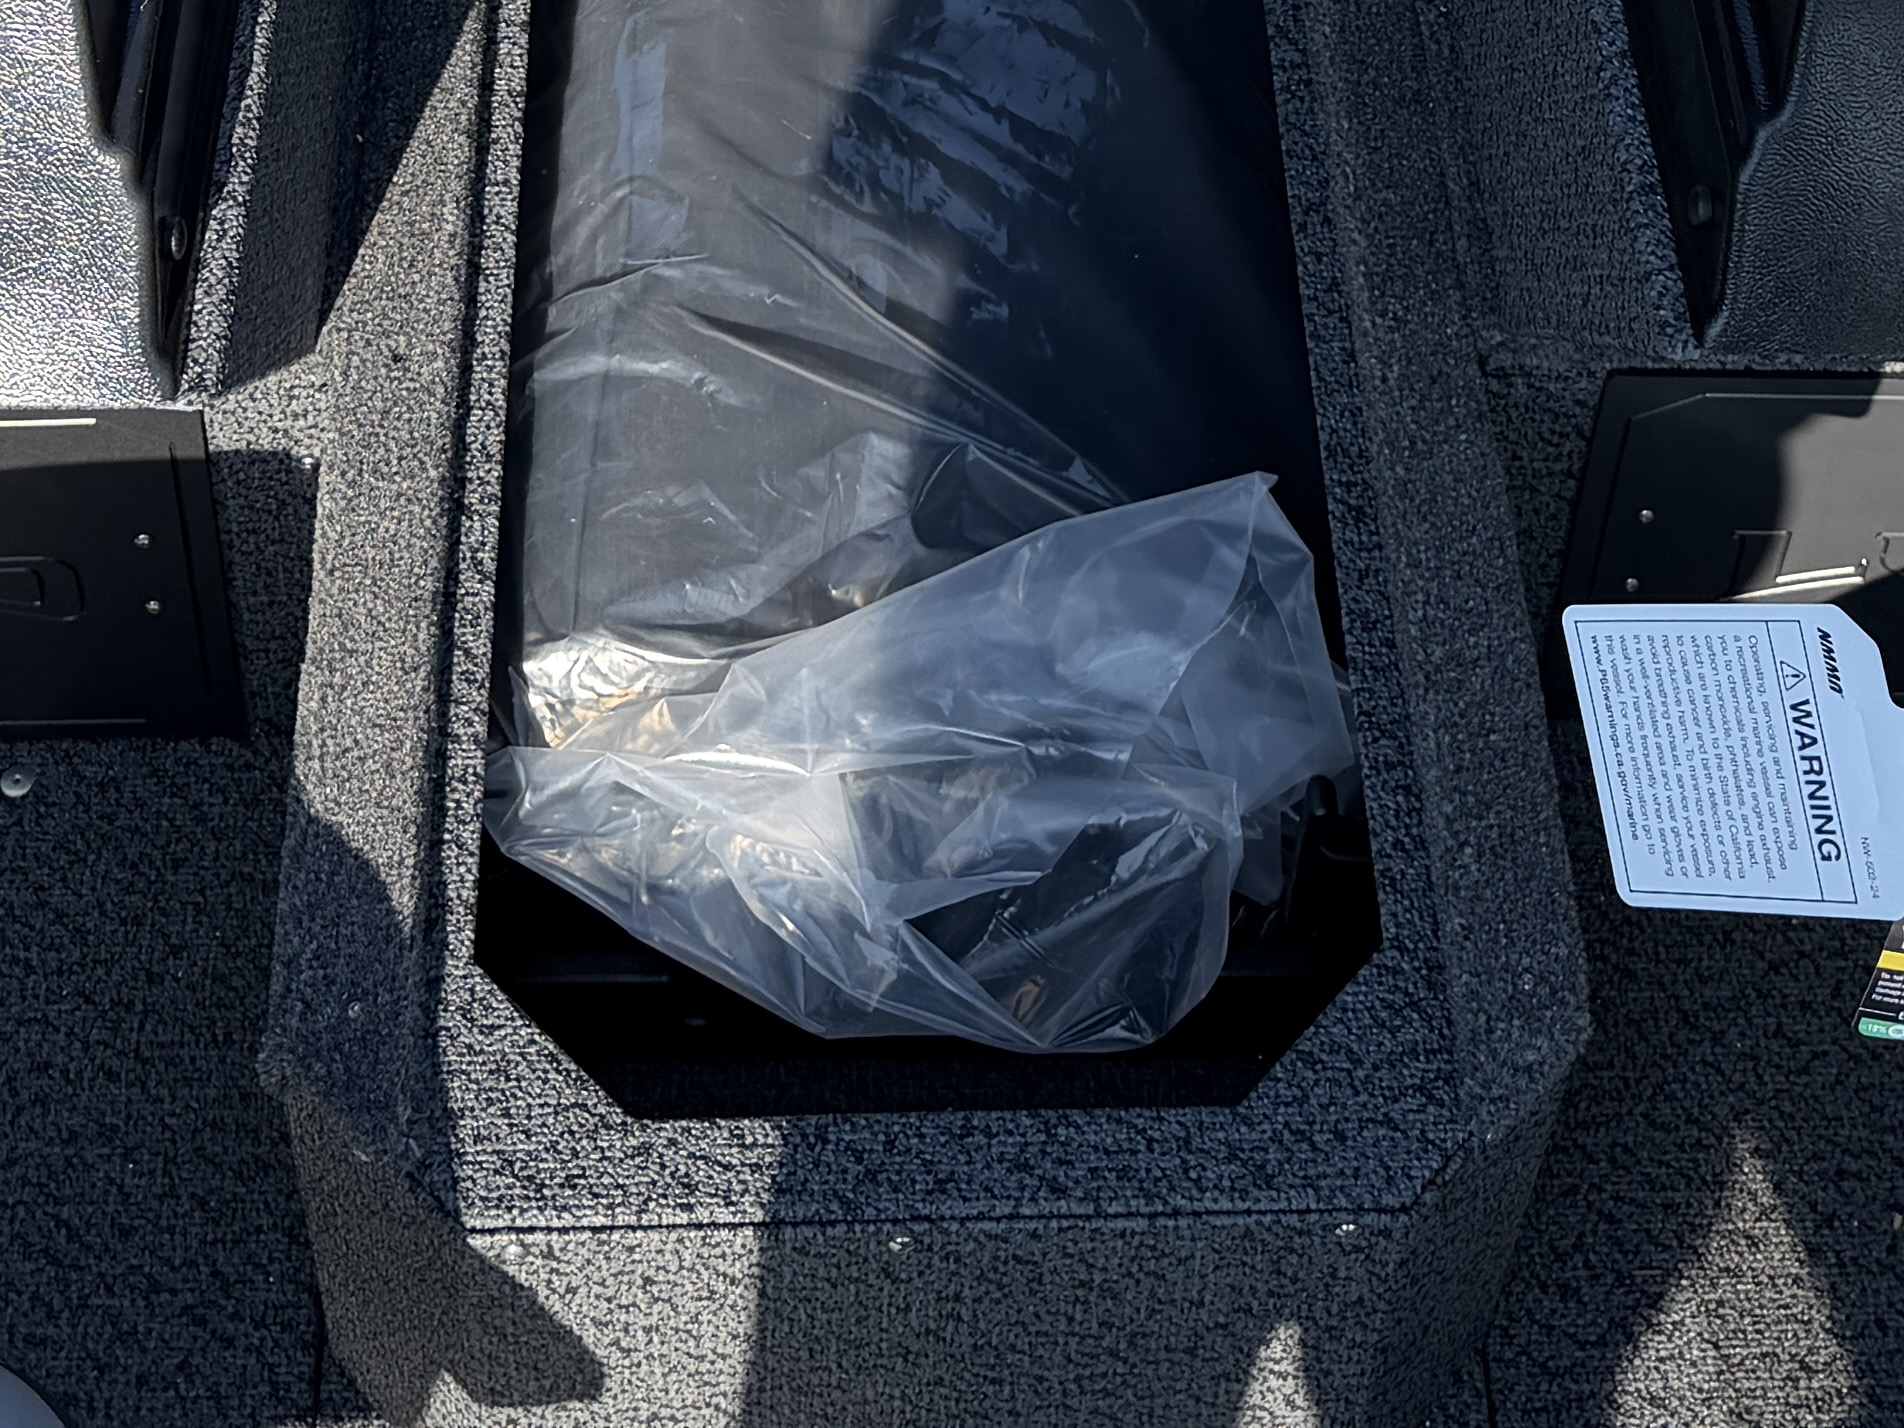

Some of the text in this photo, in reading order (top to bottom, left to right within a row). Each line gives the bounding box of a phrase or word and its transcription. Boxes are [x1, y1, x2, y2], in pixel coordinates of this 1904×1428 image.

[1604, 634, 1617, 655] this
[1618, 634, 1633, 664] wash
[1645, 634, 1662, 664] avoid
[1688, 634, 1705, 669] which
[1622, 667, 1638, 693] your
[1677, 649, 1693, 685] cause
[1696, 672, 1709, 691] are
[1617, 700, 1631, 720] For
[1630, 695, 1647, 731] hands
[1685, 688, 1702, 729] cancer
[1700, 694, 1719, 734] known
[1622, 723, 1636, 753] more
[1694, 731, 1708, 754] and
[1702, 634, 1721, 676] carbon
[1739, 813, 1753, 836] and
[1715, 634, 1730, 656] you
[1747, 791, 1768, 831] engine
[1748, 717, 1768, 758] marine
[1653, 740, 1667, 766] area
[1712, 752, 1726, 772] the
[1771, 756, 1787, 781] and
[1659, 768, 1674, 791] and
[1699, 757, 1715, 785] birth
[1757, 760, 1775, 798] vessel
[1785, 698, 1844, 862] WARNING
[1674, 773, 1692, 813] service
[1717, 774, 1734, 806] State
[1650, 791, 1666, 824] when
[1664, 793, 1678, 823] wear
[1705, 786, 1724, 831] defects
[1766, 800, 1779, 823] can
[1680, 814, 1696, 841] your
[1688, 841, 1704, 878] vessel
[1769, 826, 1788, 870] expose
[1718, 849, 1734, 882] other
